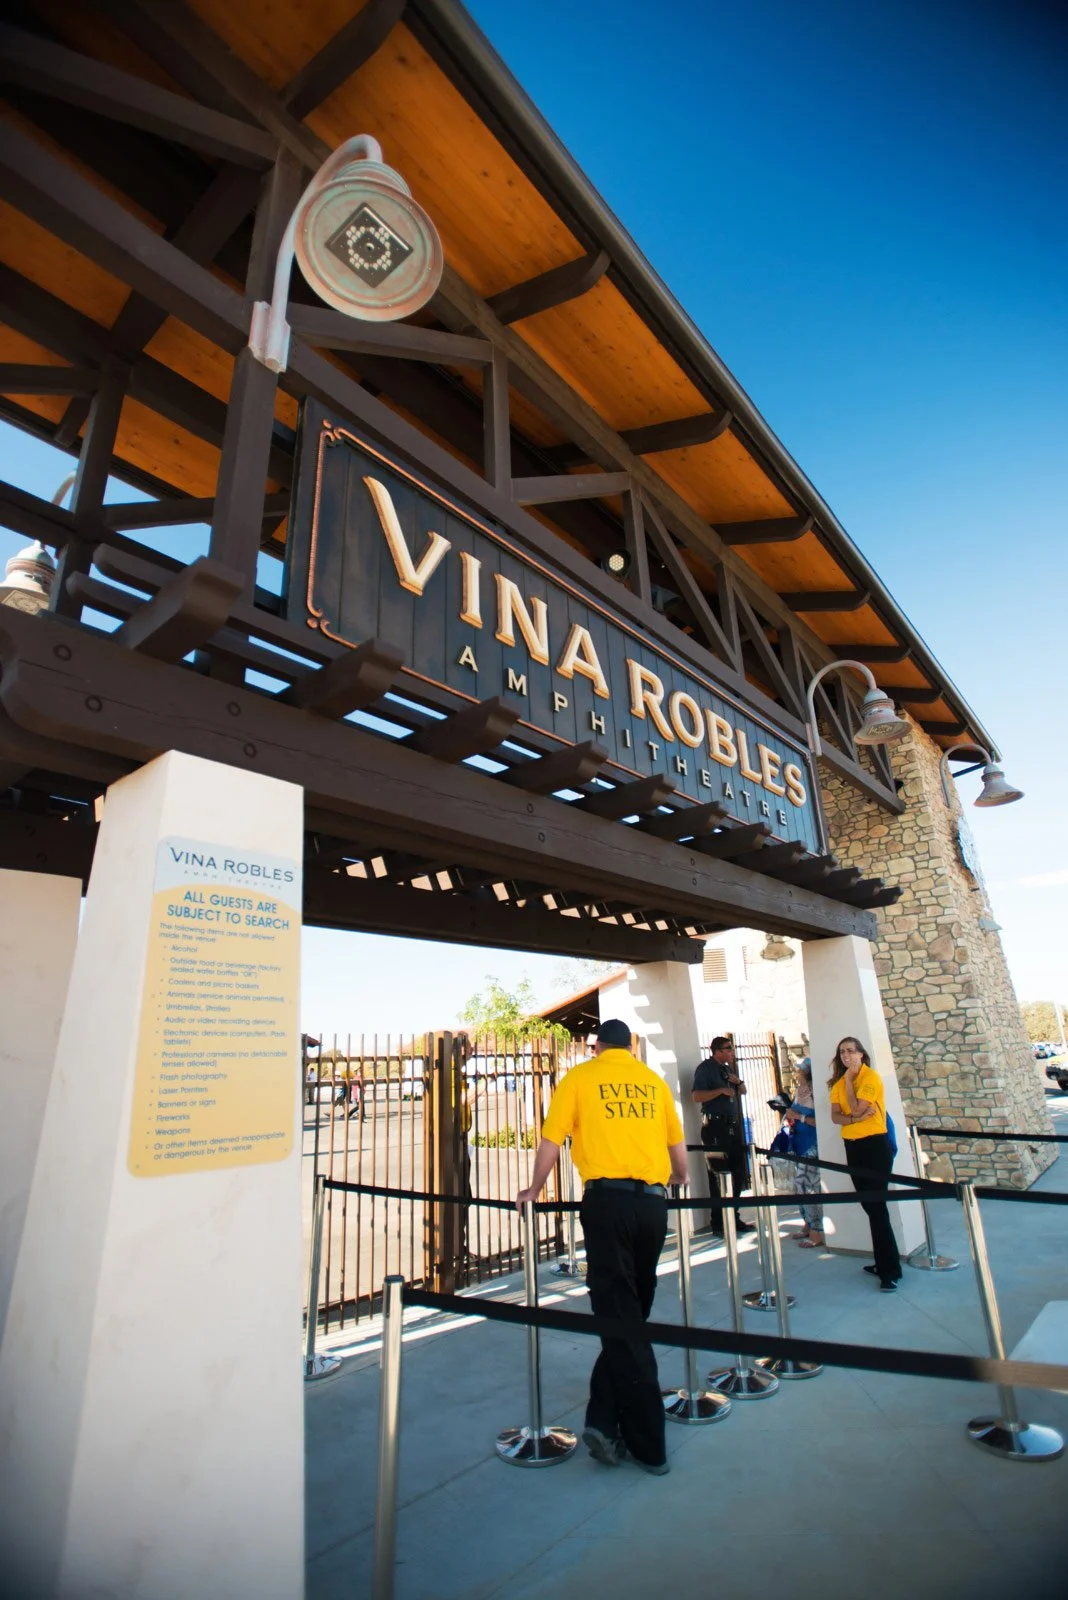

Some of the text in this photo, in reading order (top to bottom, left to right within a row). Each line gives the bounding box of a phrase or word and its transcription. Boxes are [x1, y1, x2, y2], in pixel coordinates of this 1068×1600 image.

[363, 475, 807, 807] VINA ROBLES
[458, 645, 787, 826] AMPHITHEATRE
[170, 847, 294, 882] VINA ROBLES
[184, 890, 278, 914] ALL GUESTS ARE
[167, 904, 289, 930] SUBJECT TO SEARCH
[181, 1072, 227, 1082] photography
[598, 1083, 657, 1100] EVENT
[158, 1101, 187, 1109] Banners
[605, 1101, 656, 1119] STAFF
[155, 1128, 191, 1136] Weapons
[154, 1143, 163, 1151] Or
[164, 1149, 205, 1160] dangerous
[206, 1148, 216, 1156] by
